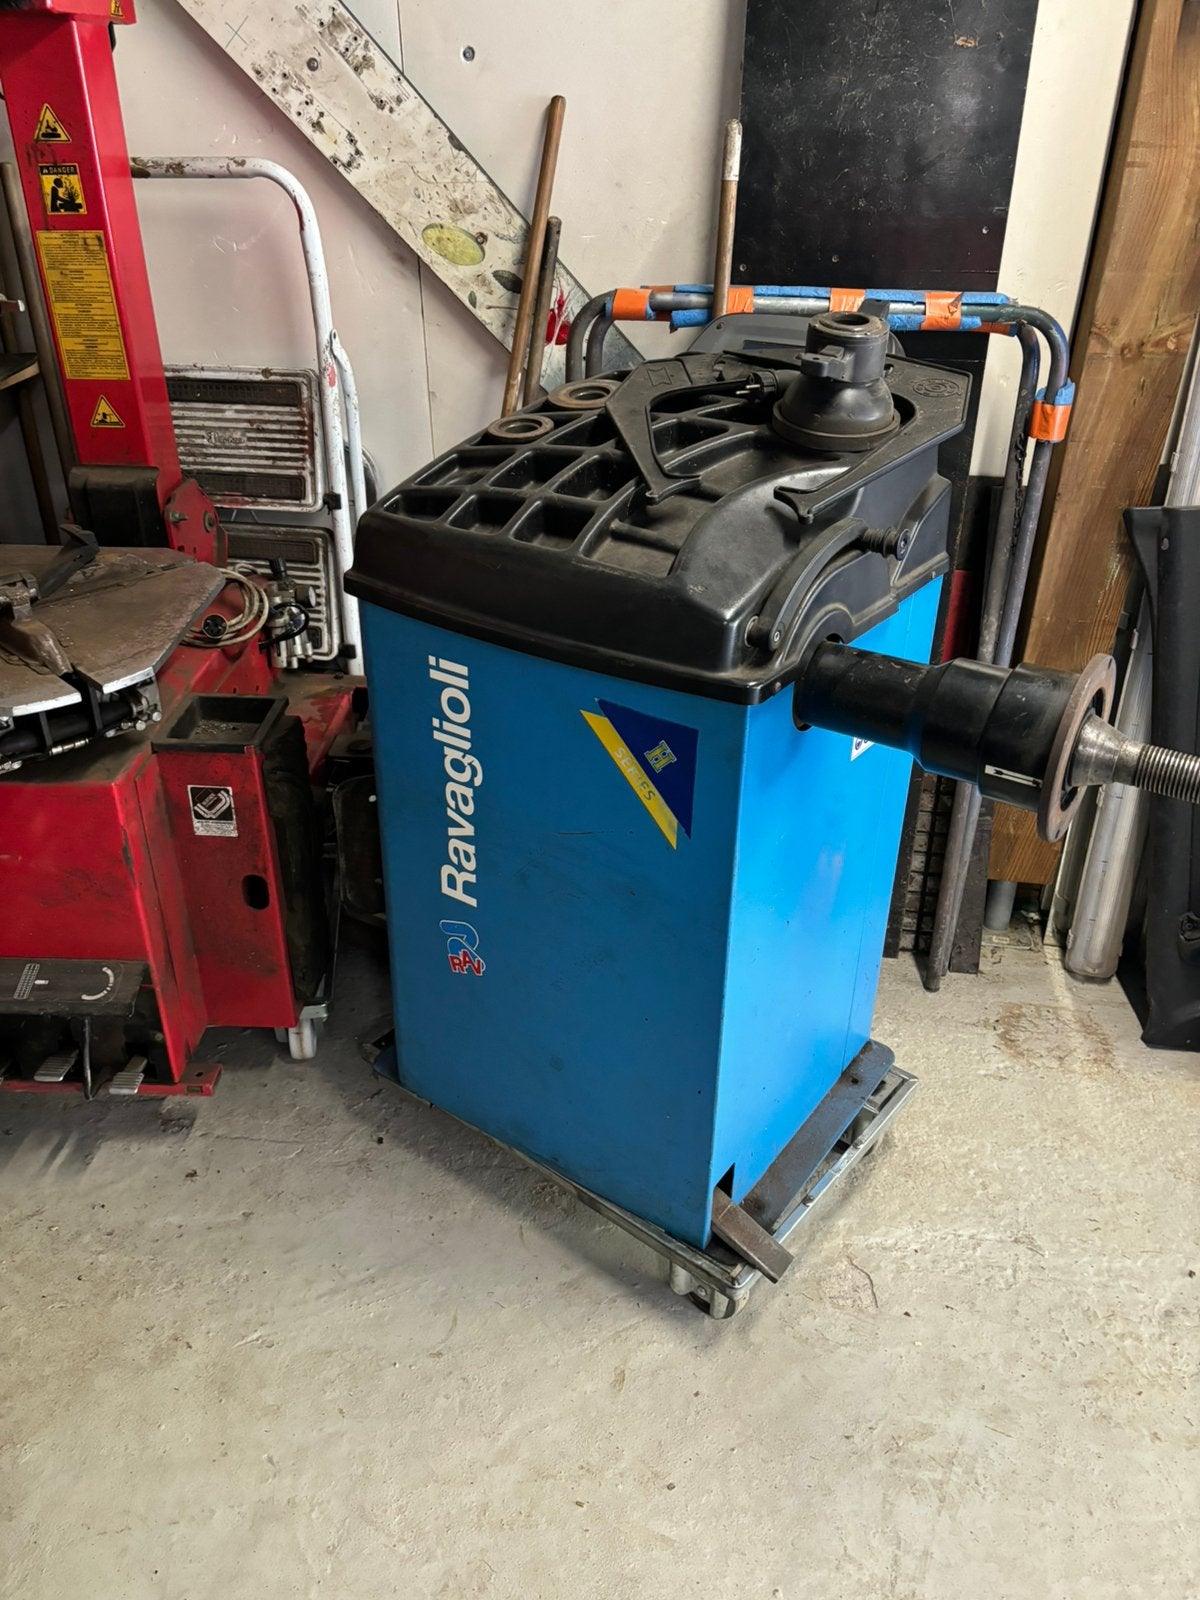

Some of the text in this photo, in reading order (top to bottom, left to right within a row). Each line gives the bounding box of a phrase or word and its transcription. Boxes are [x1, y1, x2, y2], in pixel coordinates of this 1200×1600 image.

[49, 166, 75, 174] DANGER
[428, 655, 484, 908] Ravaglioli
[614, 747, 656, 801] SERIES
[447, 949, 484, 977] RAV
